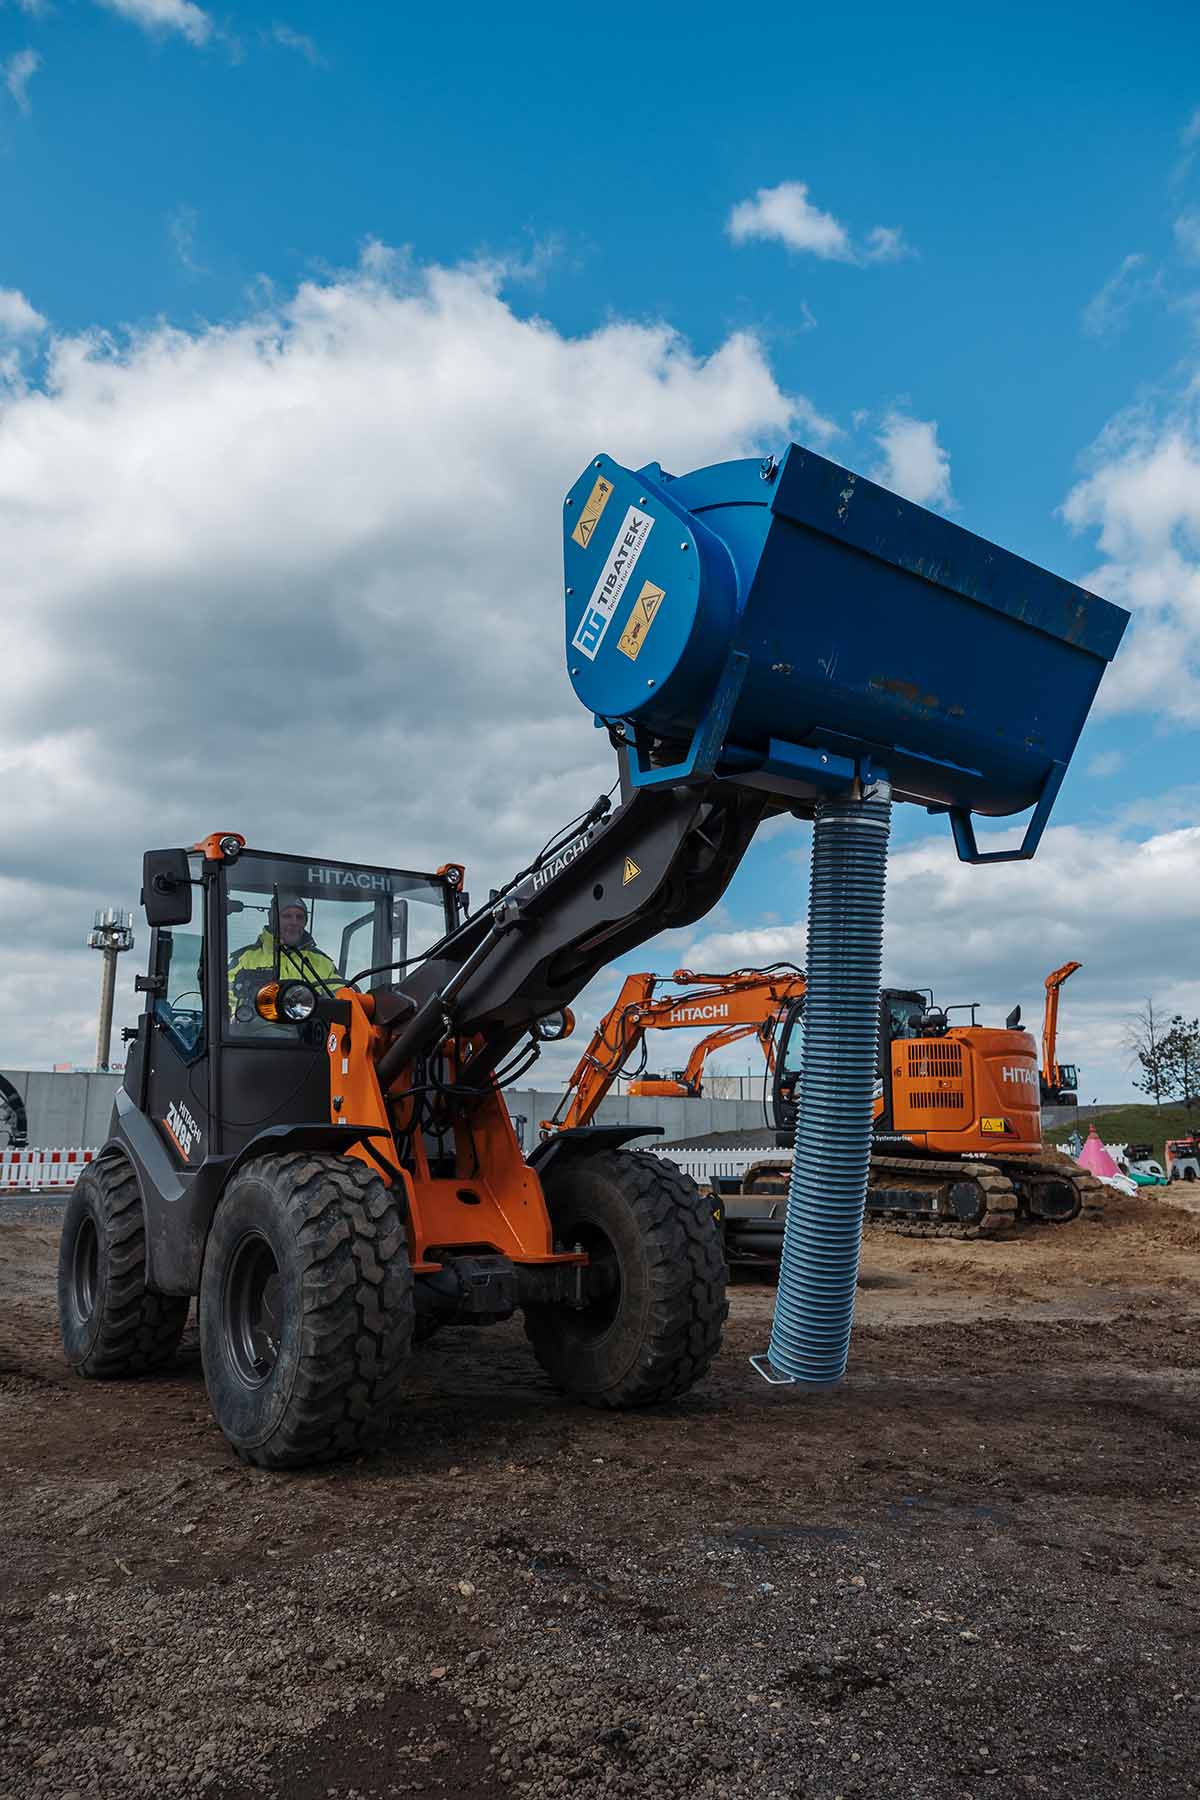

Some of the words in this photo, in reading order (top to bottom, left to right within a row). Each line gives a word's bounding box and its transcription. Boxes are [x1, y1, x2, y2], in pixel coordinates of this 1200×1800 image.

[597, 516, 643, 605] TIBATEK
[607, 583, 623, 611] Technik
[627, 554, 636, 569] den
[633, 522, 650, 552] Tiefbau
[307, 868, 391, 892] HITACHI
[532, 836, 590, 891] HITACHI
[670, 1003, 729, 1022] HITACHI
[166, 1101, 192, 1155] ZW95
[179, 1100, 202, 1144] HITACHI
